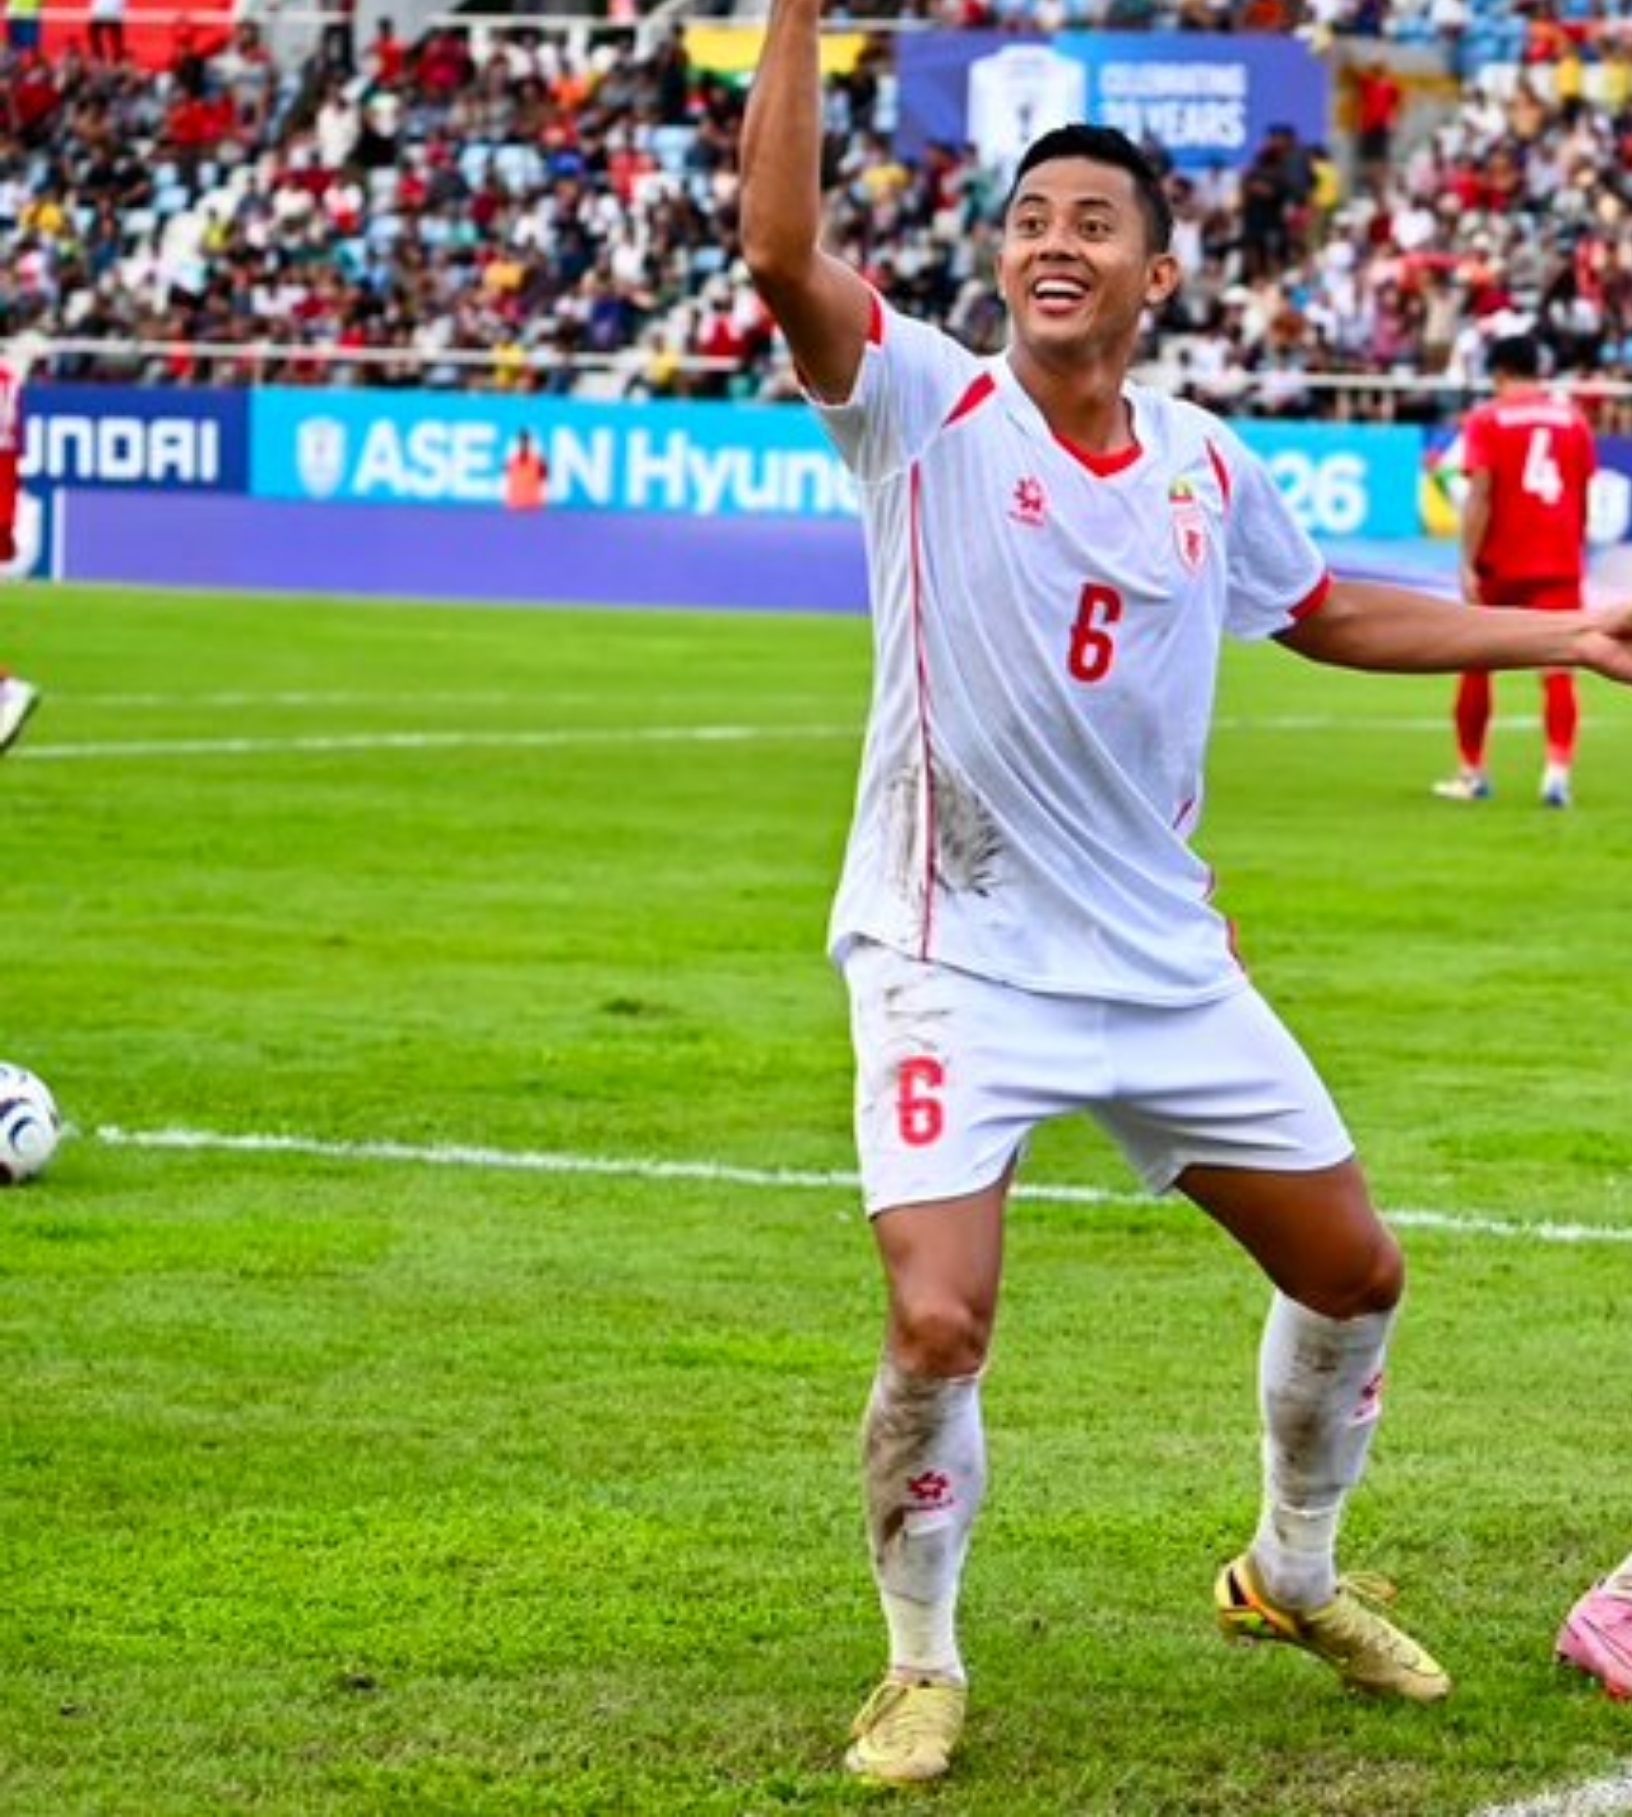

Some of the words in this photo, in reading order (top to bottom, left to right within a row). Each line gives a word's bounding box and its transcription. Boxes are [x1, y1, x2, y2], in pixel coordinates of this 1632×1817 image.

[352, 415, 613, 506] ASEN
[1521, 427, 1564, 505] 4
[1067, 580, 1124, 684] 6
[897, 1055, 944, 1148] 6
